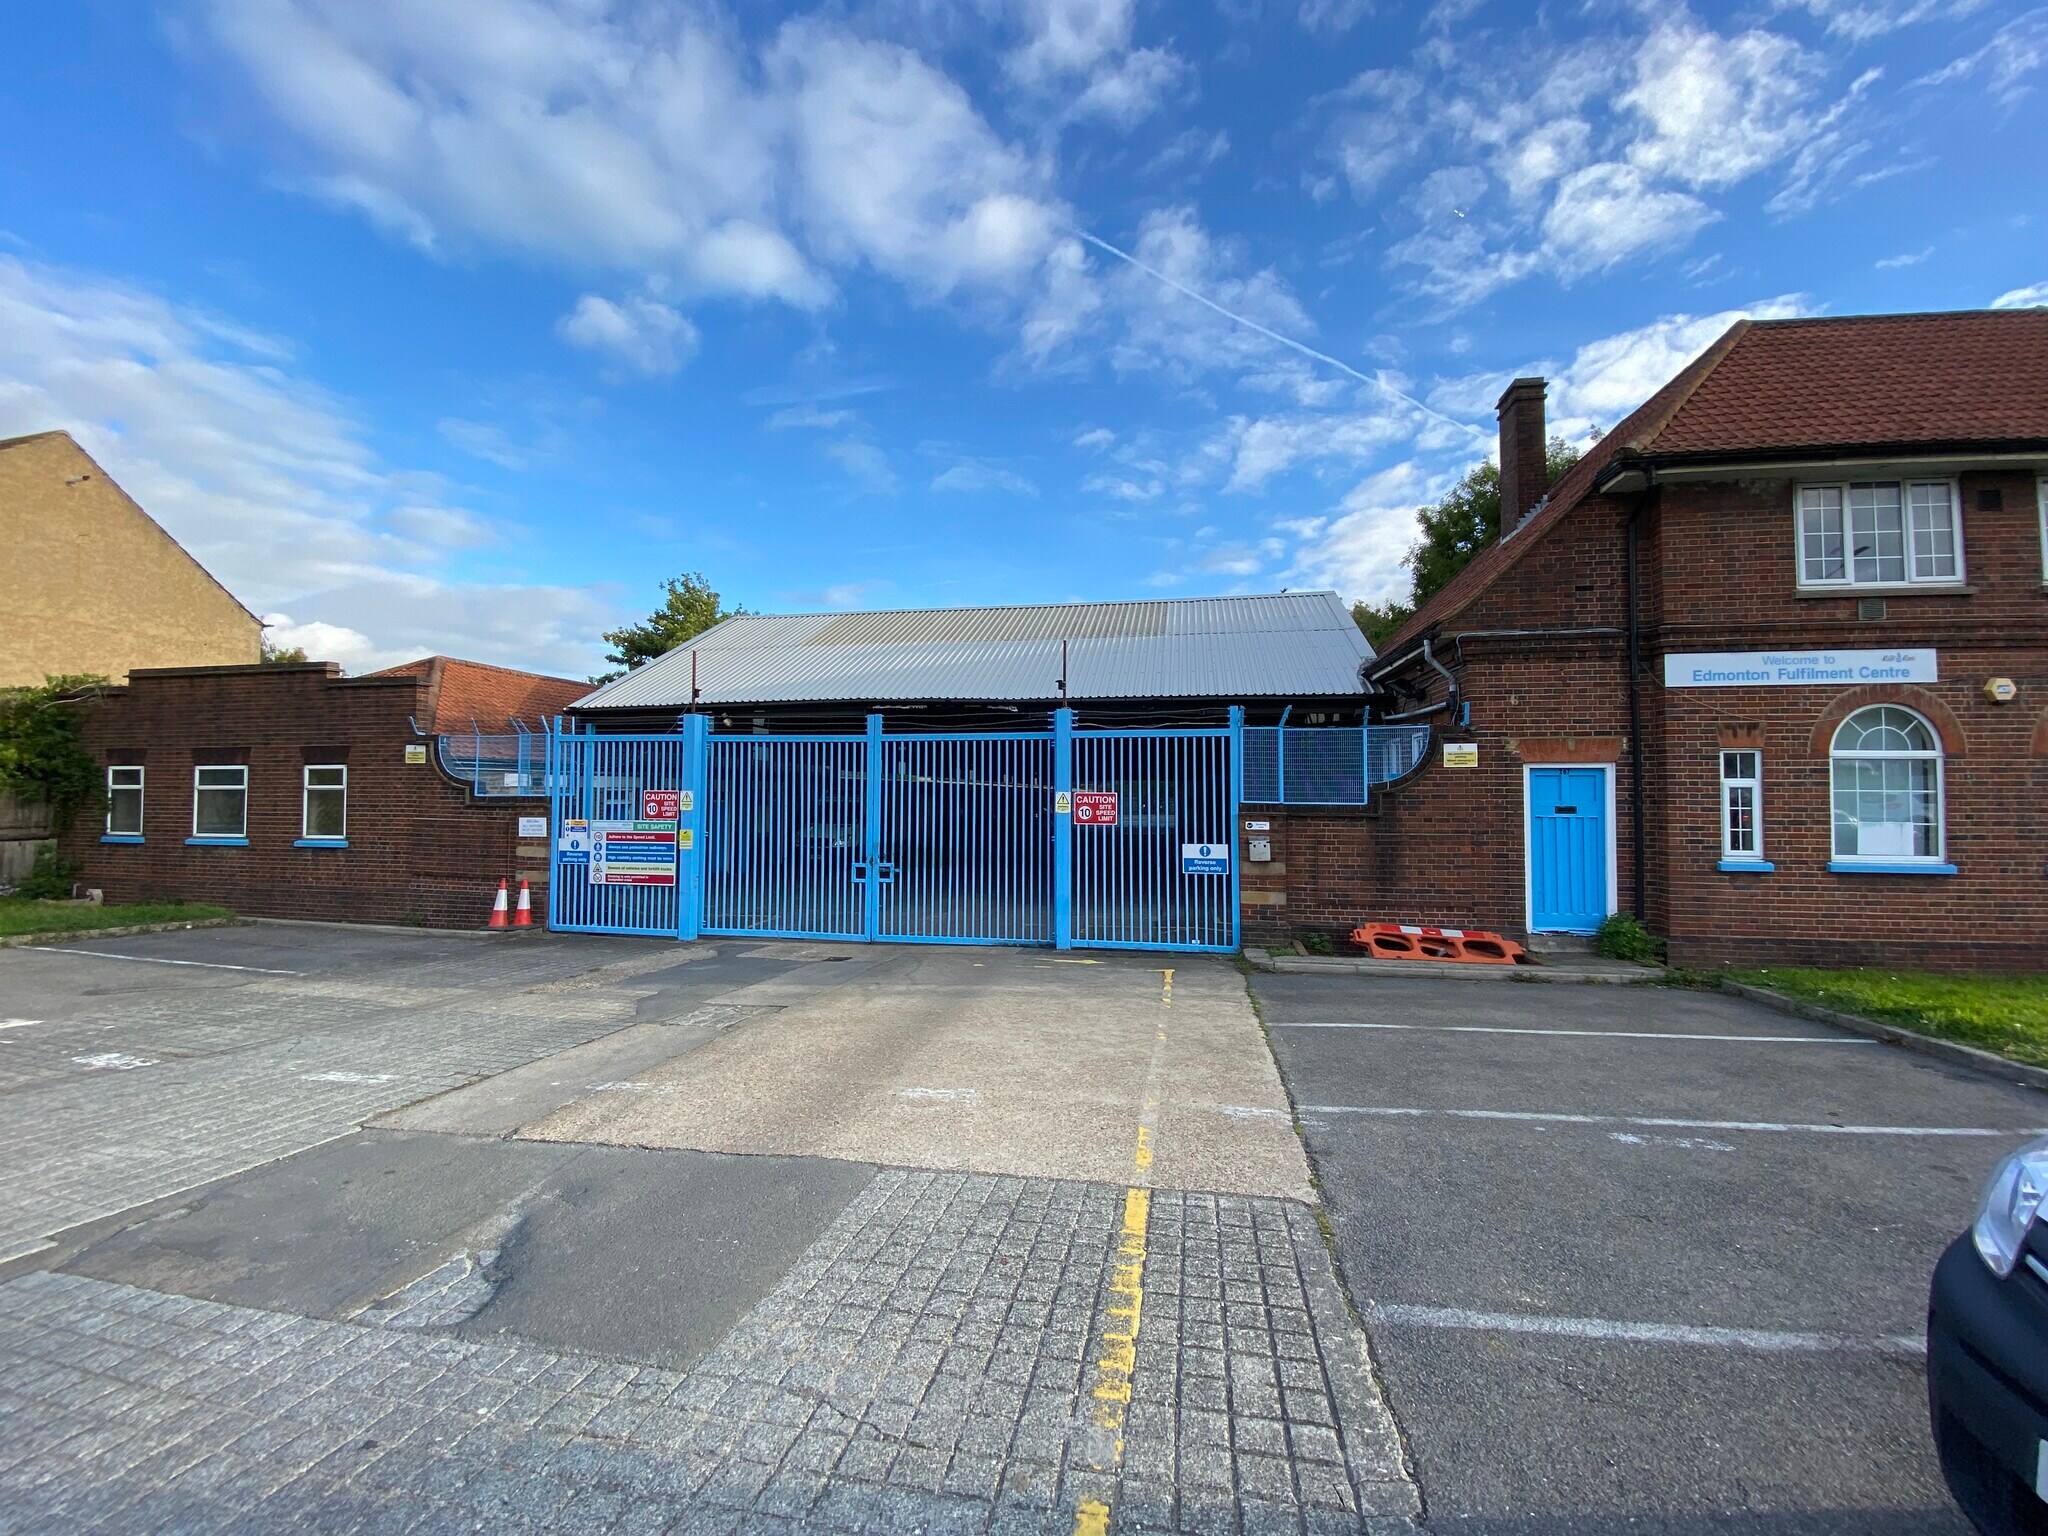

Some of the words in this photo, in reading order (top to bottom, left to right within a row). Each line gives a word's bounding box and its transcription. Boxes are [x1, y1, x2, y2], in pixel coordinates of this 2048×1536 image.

[1762, 655, 1819, 666] Welcome
[1824, 655, 1835, 664] to
[1693, 669, 1770, 681] Edmonton
[1778, 667, 1854, 680] Fulfilment
[1859, 666, 1910, 679] Centre
[1080, 808, 1090, 817] 10
